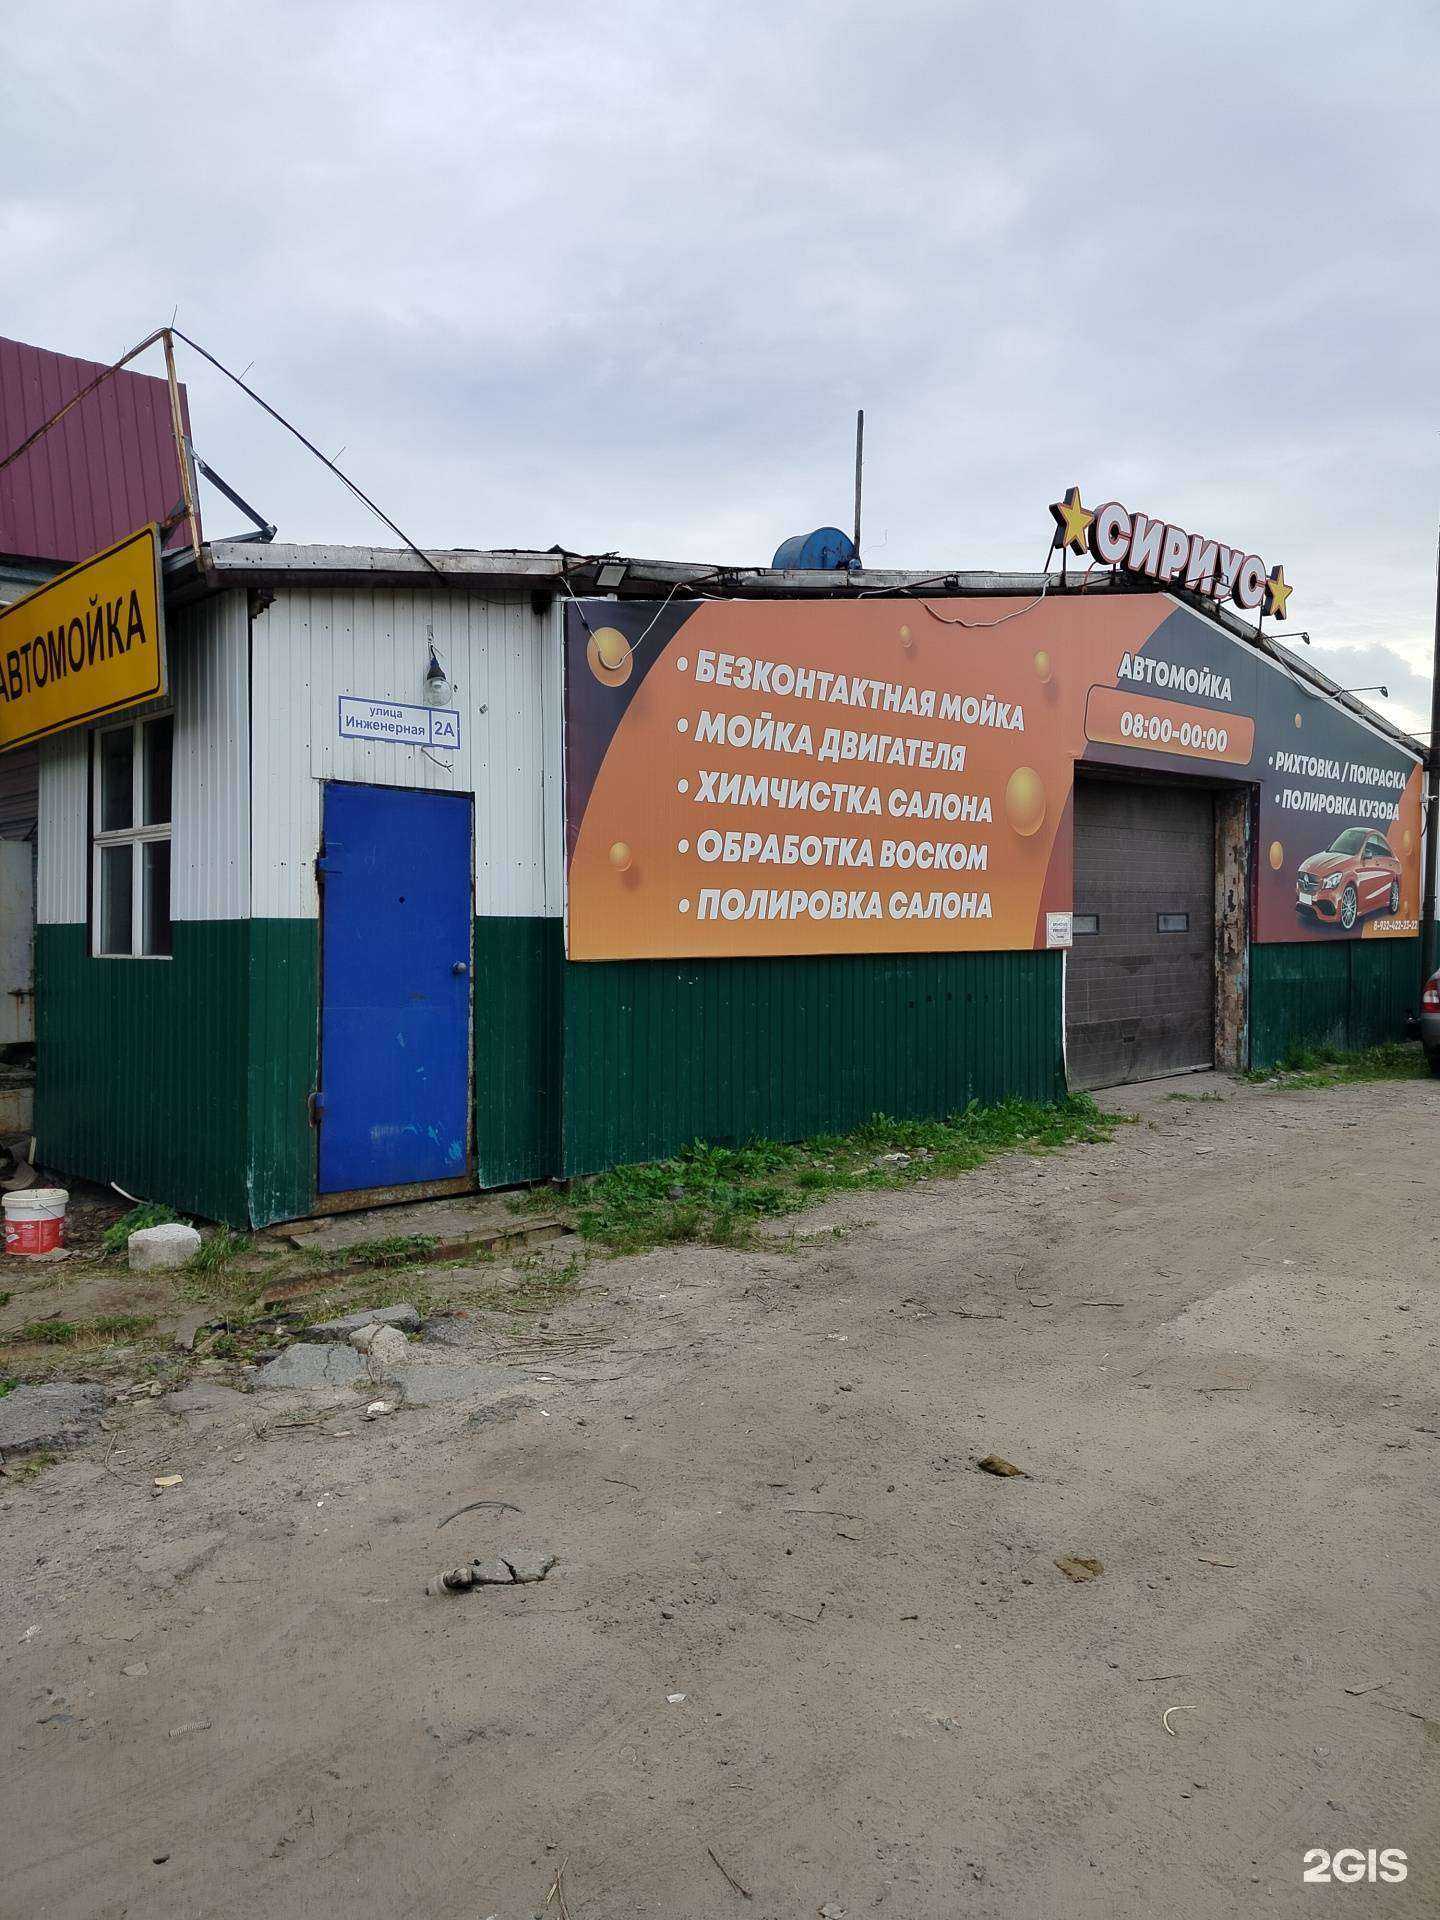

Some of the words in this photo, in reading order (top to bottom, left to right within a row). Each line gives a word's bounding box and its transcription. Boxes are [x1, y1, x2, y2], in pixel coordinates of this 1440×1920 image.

[1094, 501, 1267, 609] СИРИУС
[695, 649, 936, 718] БЕЗКОНТАКТНАЯ
[938, 693, 1025, 732] МОЙКА
[1117, 652, 1232, 702] АВТОМОЙКА
[345, 715, 425, 736] Инженерная
[369, 707, 403, 719] улица
[434, 721, 455, 737] 2А
[1120, 711, 1228, 753] 08:00-00:00
[694, 710, 813, 756] МОЙКА
[817, 727, 967, 772] ДВИГАТЕЛЯ
[1275, 751, 1340, 780] РИХТОВКА
[1349, 764, 1406, 790] ПОКРАСКА
[694, 770, 882, 816] ХИМЧИСТКА
[888, 788, 993, 823] САЛОНА
[1281, 788, 1357, 816] ПОЛИРОВКА
[1358, 799, 1400, 821] КУЗОВА
[697, 829, 874, 867] ОБРАБОТКА
[880, 840, 988, 871] ВОСКОМ
[696, 888, 883, 920] ПОЛИРОВКА
[888, 891, 993, 920] САЛОНА
